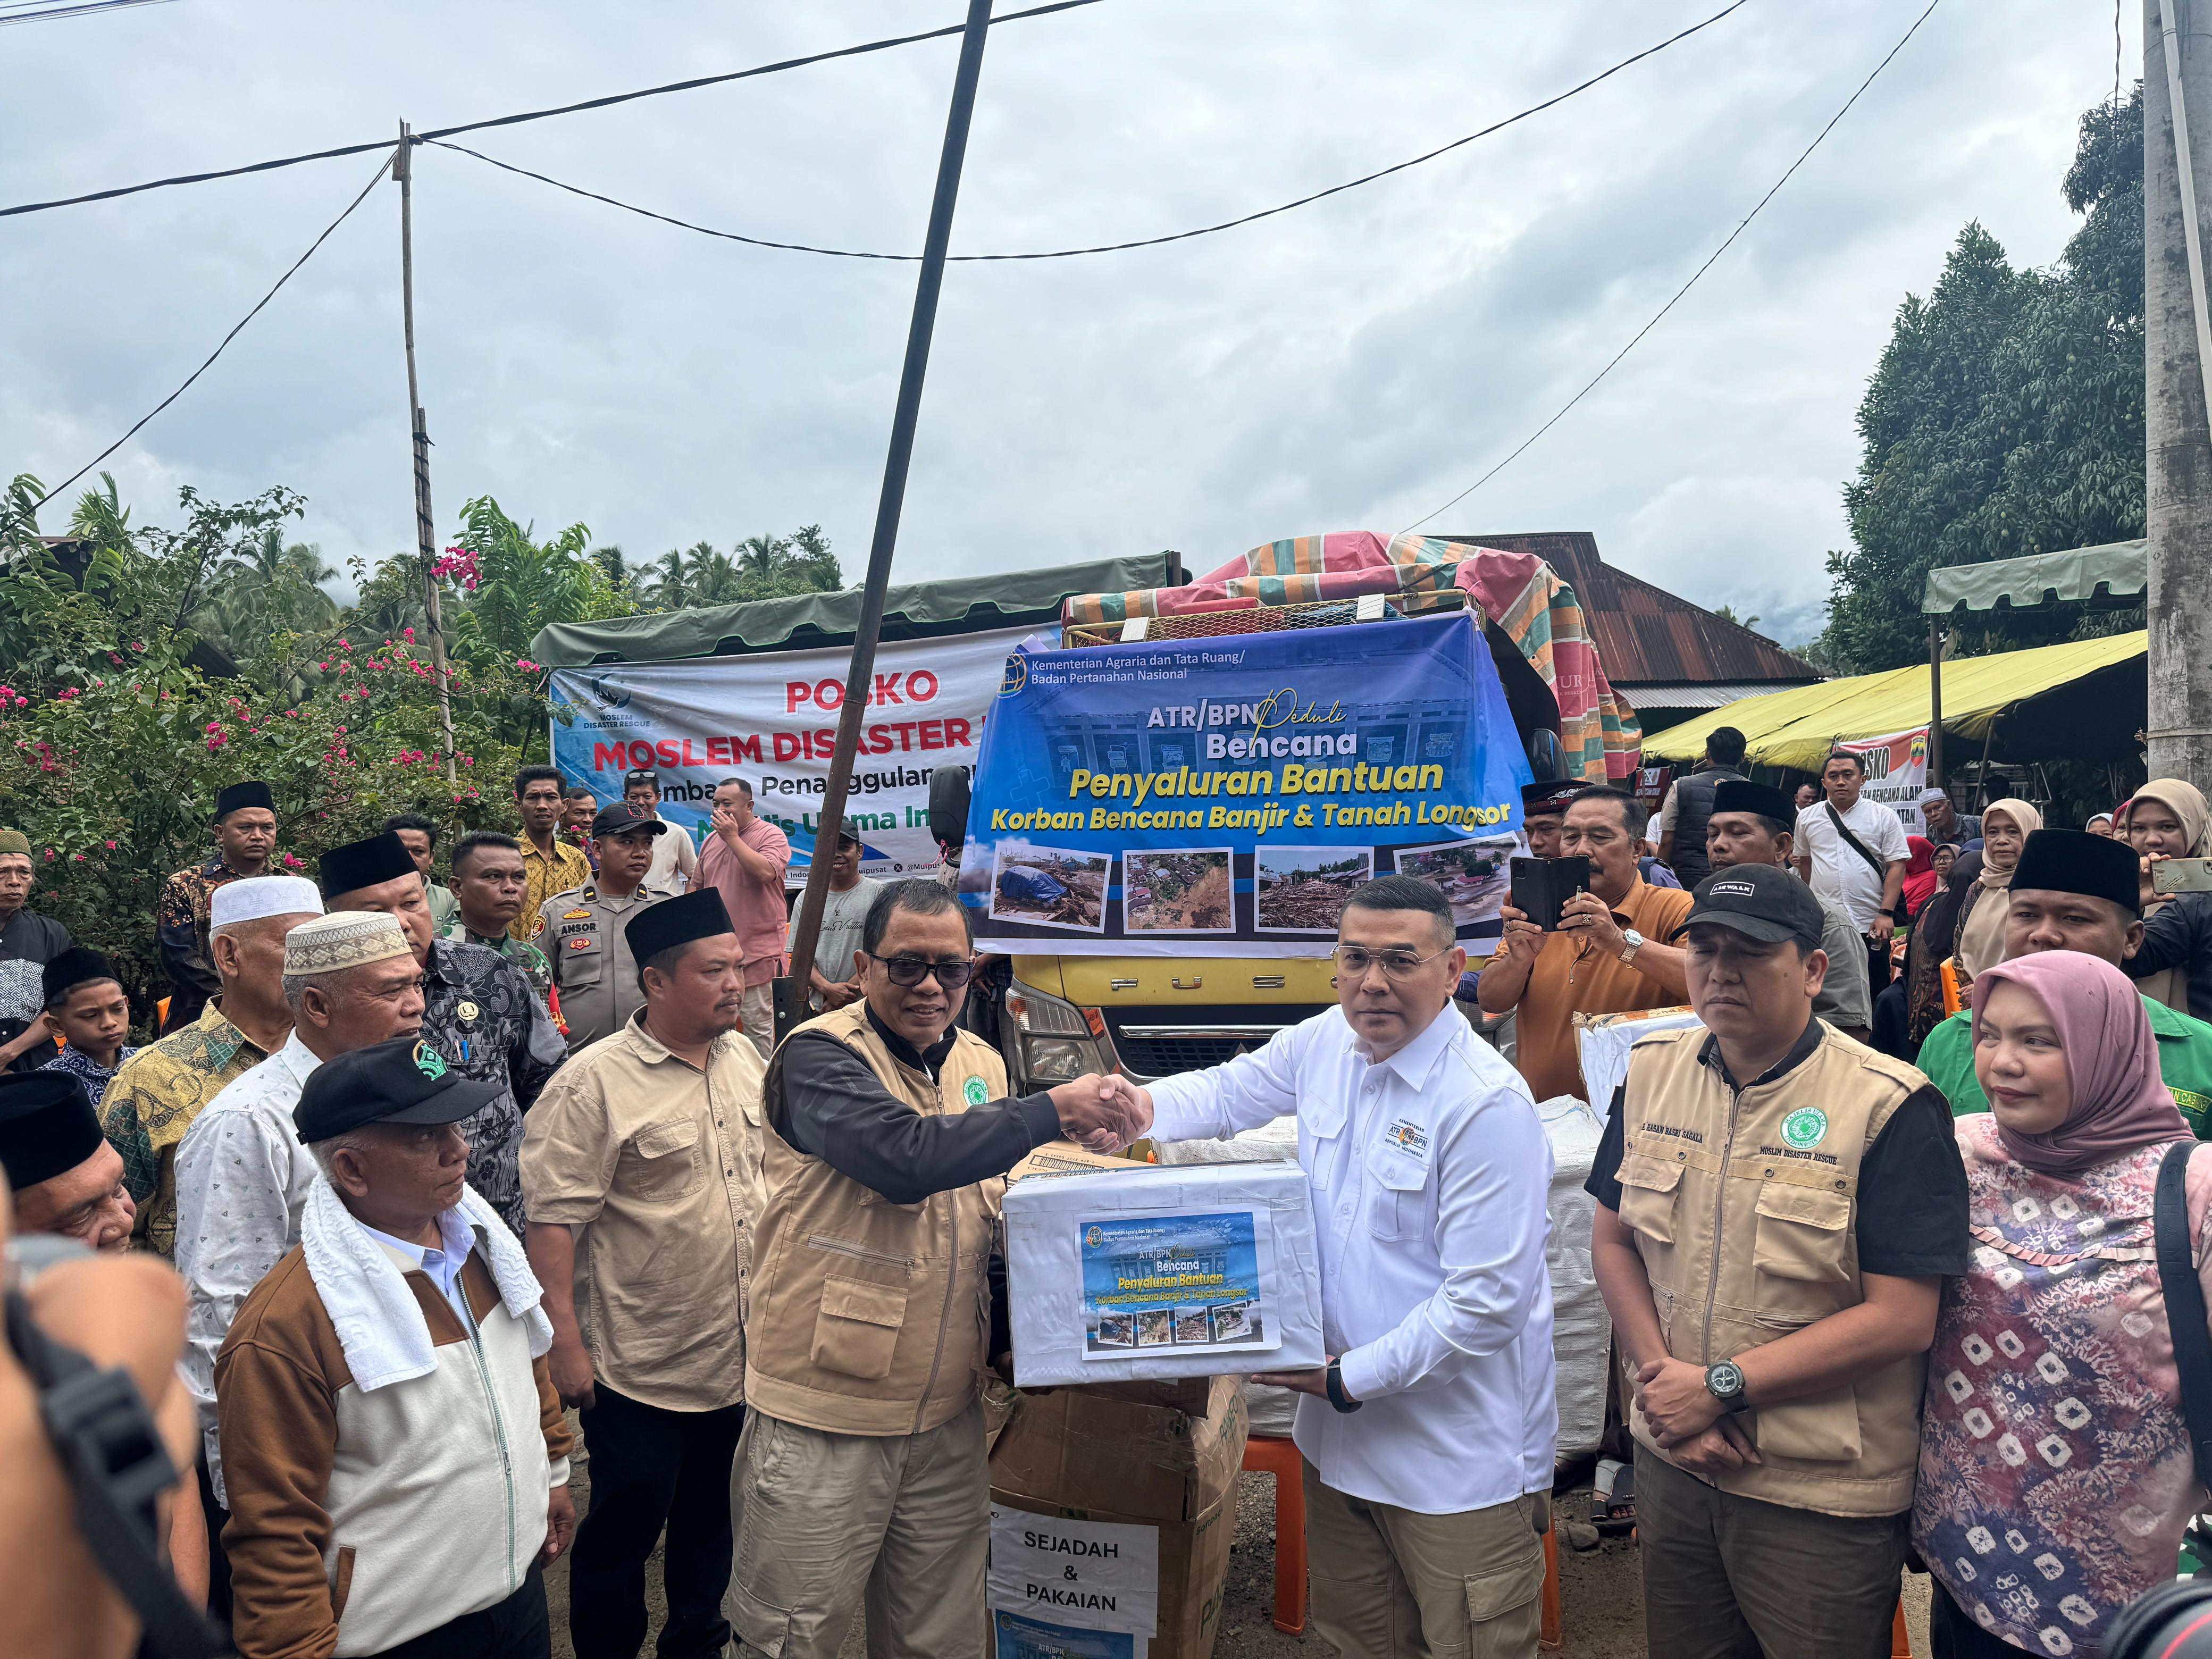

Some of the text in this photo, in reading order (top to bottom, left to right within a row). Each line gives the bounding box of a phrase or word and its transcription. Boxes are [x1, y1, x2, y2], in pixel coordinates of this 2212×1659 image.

[1032, 649, 1246, 671] Kementerian Agraria dan Tata Ruang/
[1032, 668, 1187, 684] Badan Pertanahan Nasional
[1147, 687, 1347, 751] ATR/BPN Peduli
[594, 734, 764, 771] MOSLEM
[1207, 733, 1357, 759] Bencana
[1069, 761, 1444, 807] Penyaluran Bantuan
[991, 801, 1511, 835] Korban Bencana Banjir & Tanah Longsor
[859, 866, 886, 875] uipusat
[561, 922, 596, 935] ANSOR
[1389, 1126, 1427, 1147] ATR BPN
[1783, 1149, 1812, 1160] DISASTER
[1813, 1153, 1837, 1165] RESCUE
[1139, 1247, 1171, 1260] ATR/BPN
[1157, 1260, 1199, 1272] Bencana
[1118, 1273, 1223, 1293] Penyaluran Bantuan
[1161, 1290, 1183, 1303] Banjir
[1196, 1506, 1223, 1536] Softpac
[1024, 1531, 1118, 1559] SEJADAH
[1063, 1565, 1078, 1581] &
[1027, 1583, 1116, 1611] PAKAIAN
